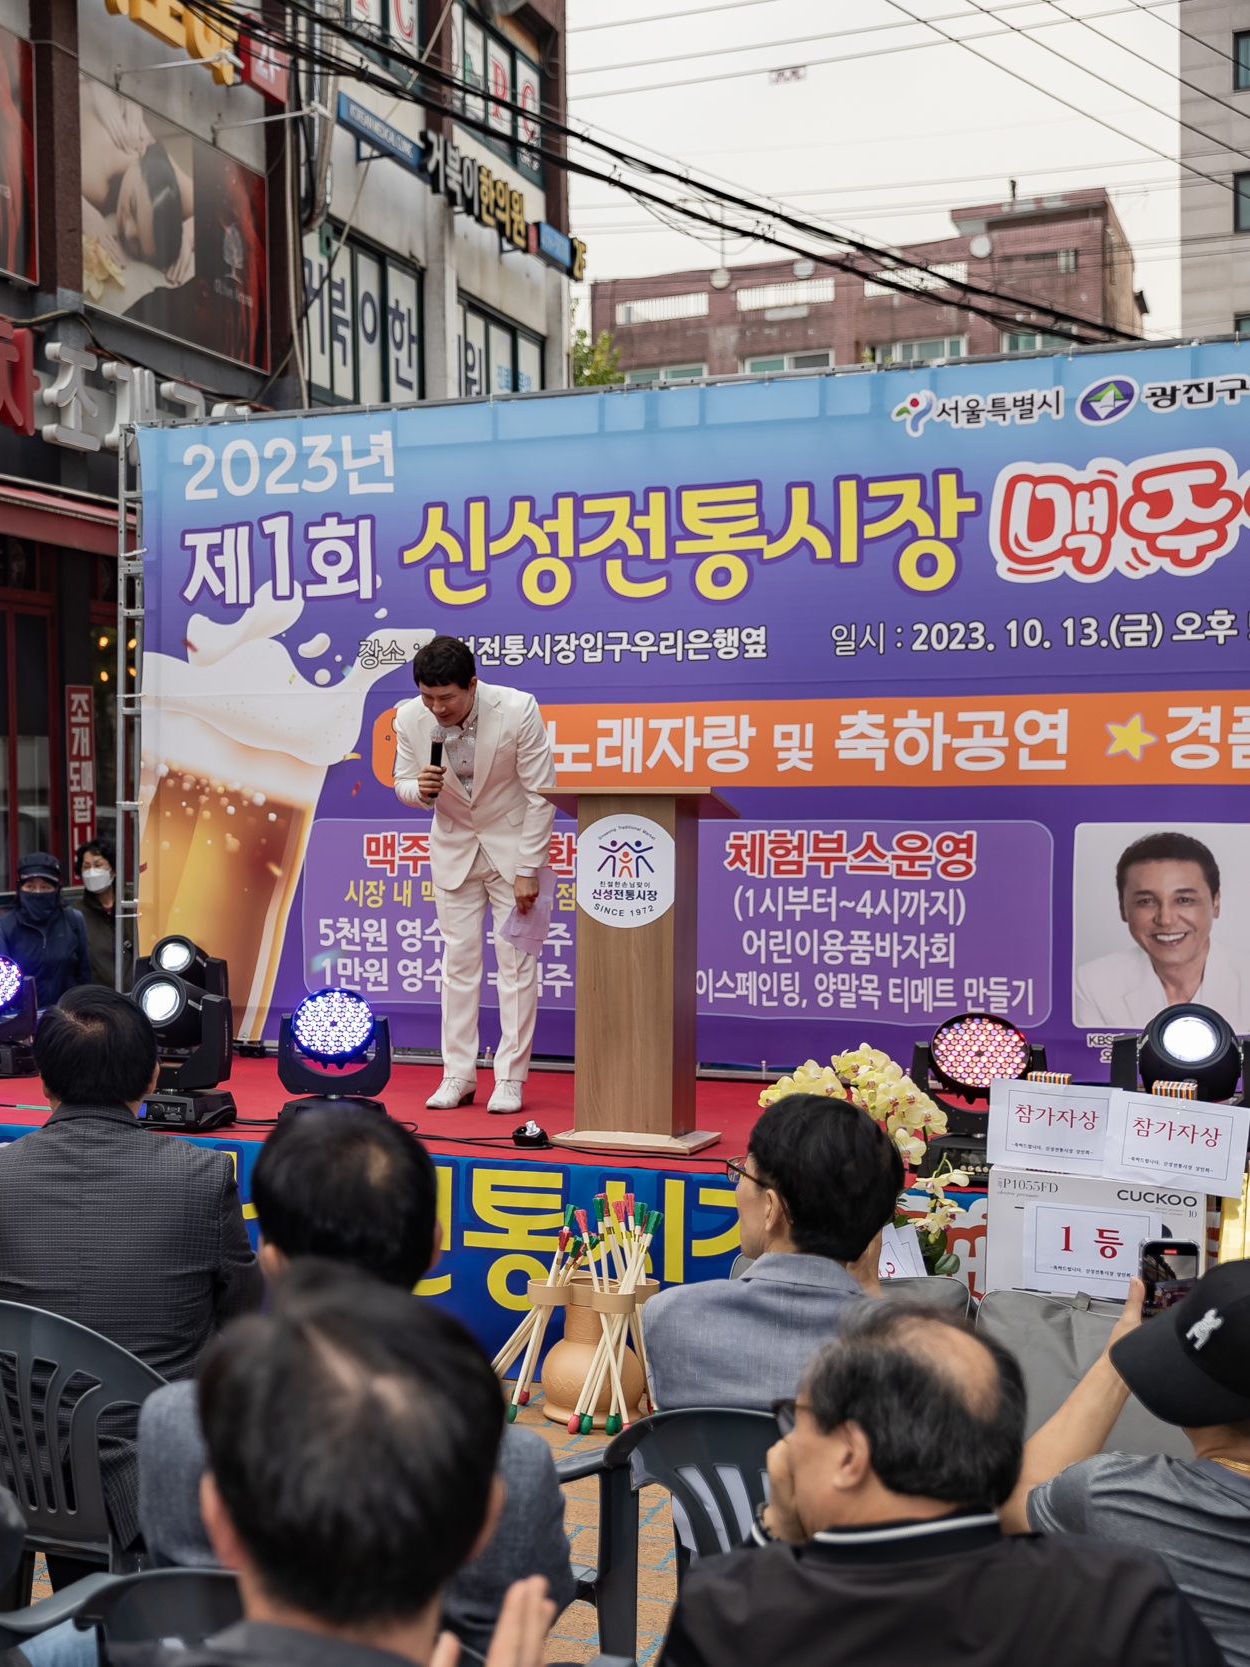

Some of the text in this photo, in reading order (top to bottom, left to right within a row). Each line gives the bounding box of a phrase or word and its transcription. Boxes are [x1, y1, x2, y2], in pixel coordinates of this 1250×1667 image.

[426, 131, 526, 249] 거북이한의원
[937, 390, 1061, 425] 서울특별시
[1145, 376, 1250, 409] 광진구
[183, 430, 395, 500] 2023년
[181, 460, 1250, 606] 제1회 신성전통시장 맥주
[831, 622, 885, 656] 일시
[910, 621, 996, 652] 2023.
[1005, 617, 1051, 650] 10.
[1061, 611, 1165, 650] 13.(금)
[1171, 608, 1239, 646] 오후
[358, 640, 406, 669] 장소
[551, 713, 756, 774] 노래자랑
[773, 723, 814, 772] 및
[834, 708, 1069, 773] 축하공연
[642, 829, 656, 841] Market
[725, 829, 977, 880] 체험부스운영
[344, 879, 385, 908] 시장
[393, 880, 412, 908] 내
[592, 888, 658, 902] 신성전통시장
[593, 903, 654, 917] SINCE 1972
[733, 885, 966, 926] (1시부터~4시까지)
[319, 917, 388, 952] 5천원
[742, 928, 956, 969] 어린이용품바자회
[321, 957, 388, 992] 1만원
[814, 972, 882, 1010] 양말목
[888, 976, 958, 1014] 티메트
[964, 977, 1035, 1016] 만들기
[1014, 1104, 1099, 1131] 참가자상
[1132, 1117, 1222, 1148] 참가자상
[1117, 1190, 1197, 1207] CUCKOO
[1188, 1210, 1197, 1218] 10
[1094, 1228, 1124, 1259] 등
